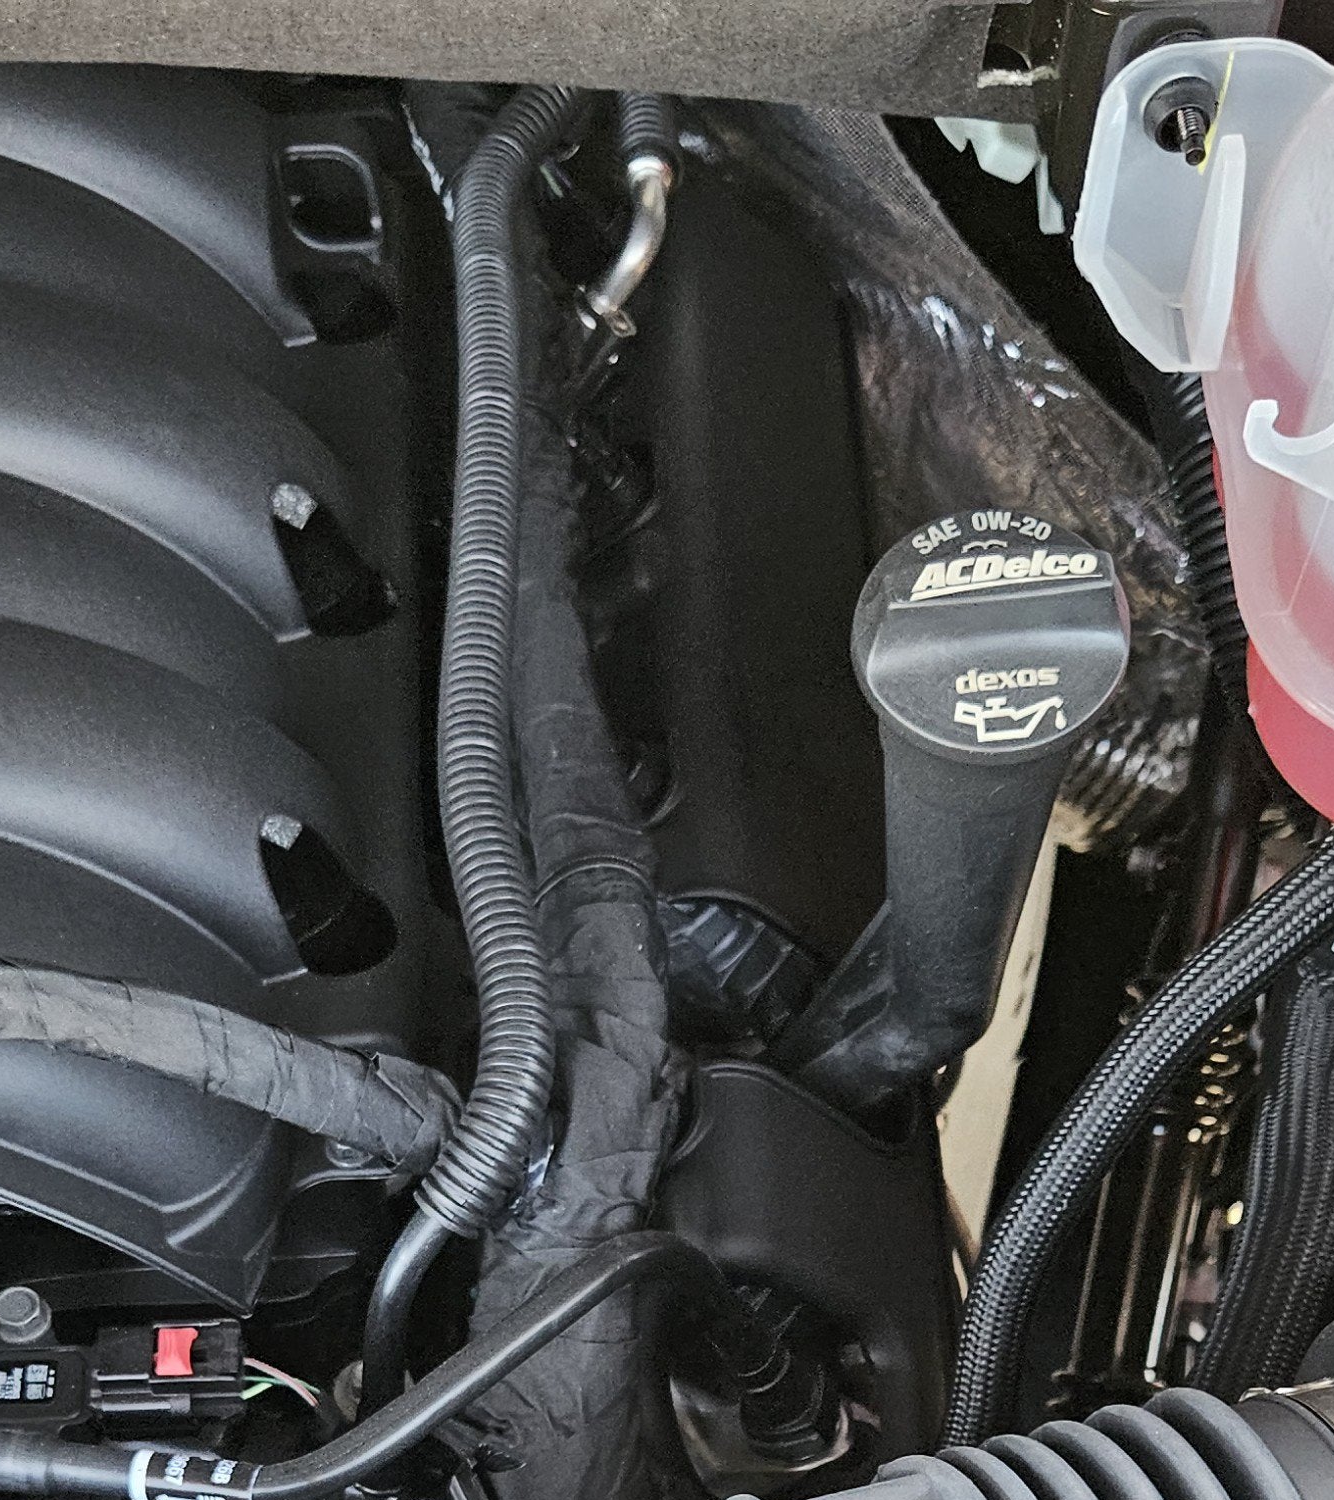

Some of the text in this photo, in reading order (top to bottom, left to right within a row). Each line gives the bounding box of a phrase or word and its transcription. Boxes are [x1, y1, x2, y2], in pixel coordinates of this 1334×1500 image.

[911, 511, 1052, 555] SAE 0W-20
[911, 550, 1098, 594] ACDelco
[955, 667, 1061, 695] dexos
